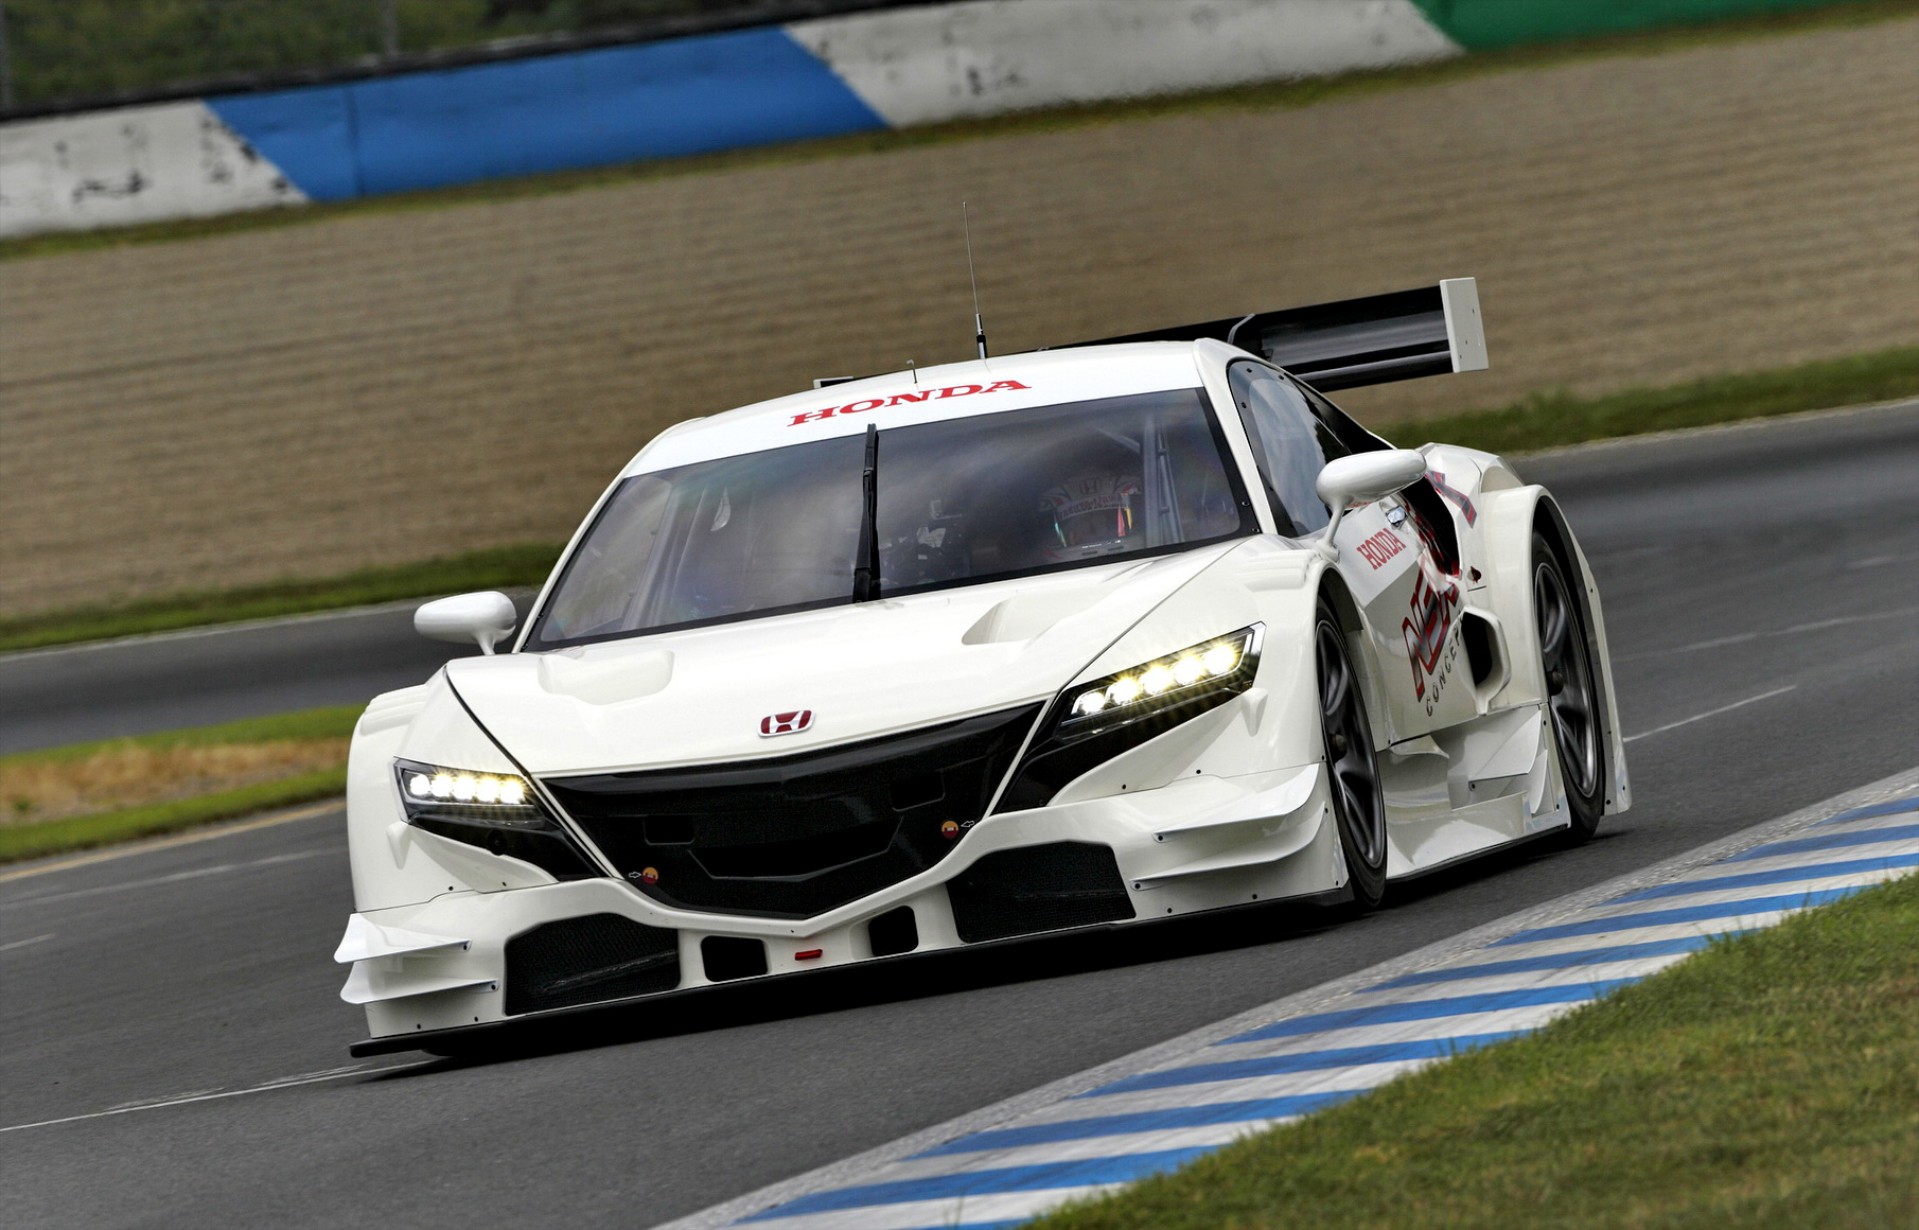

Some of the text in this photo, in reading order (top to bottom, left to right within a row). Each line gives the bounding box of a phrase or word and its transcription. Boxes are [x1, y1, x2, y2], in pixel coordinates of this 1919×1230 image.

[787, 380, 1032, 427] HONDA
[1356, 527, 1406, 570] HONDA
[1426, 608, 1463, 717] CONCEP
